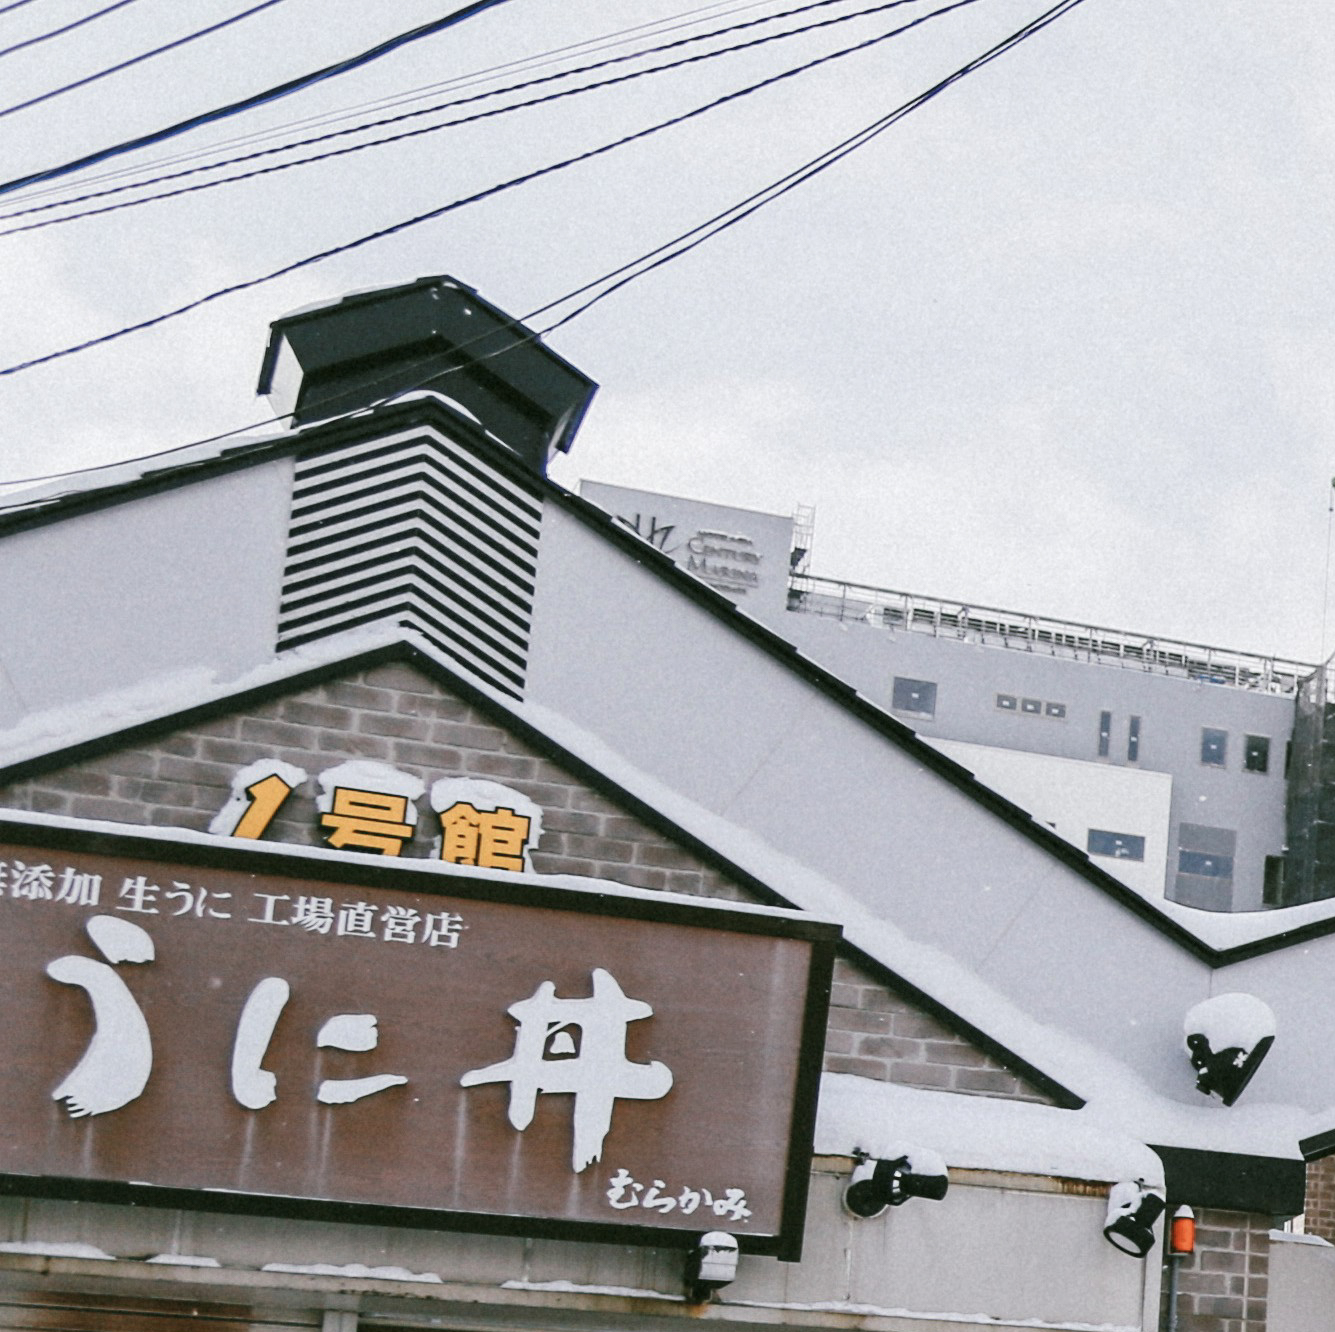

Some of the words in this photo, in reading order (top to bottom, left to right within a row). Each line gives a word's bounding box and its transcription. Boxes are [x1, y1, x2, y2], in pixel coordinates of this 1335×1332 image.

[231, 774, 532, 872] 1号館
[0, 859, 100, 909] 添加
[117, 876, 232, 922] 生うに
[248, 892, 464, 950] 工場直営店
[45, 914, 674, 1174] うに丼
[606, 1168, 753, 1222] むらかみ
